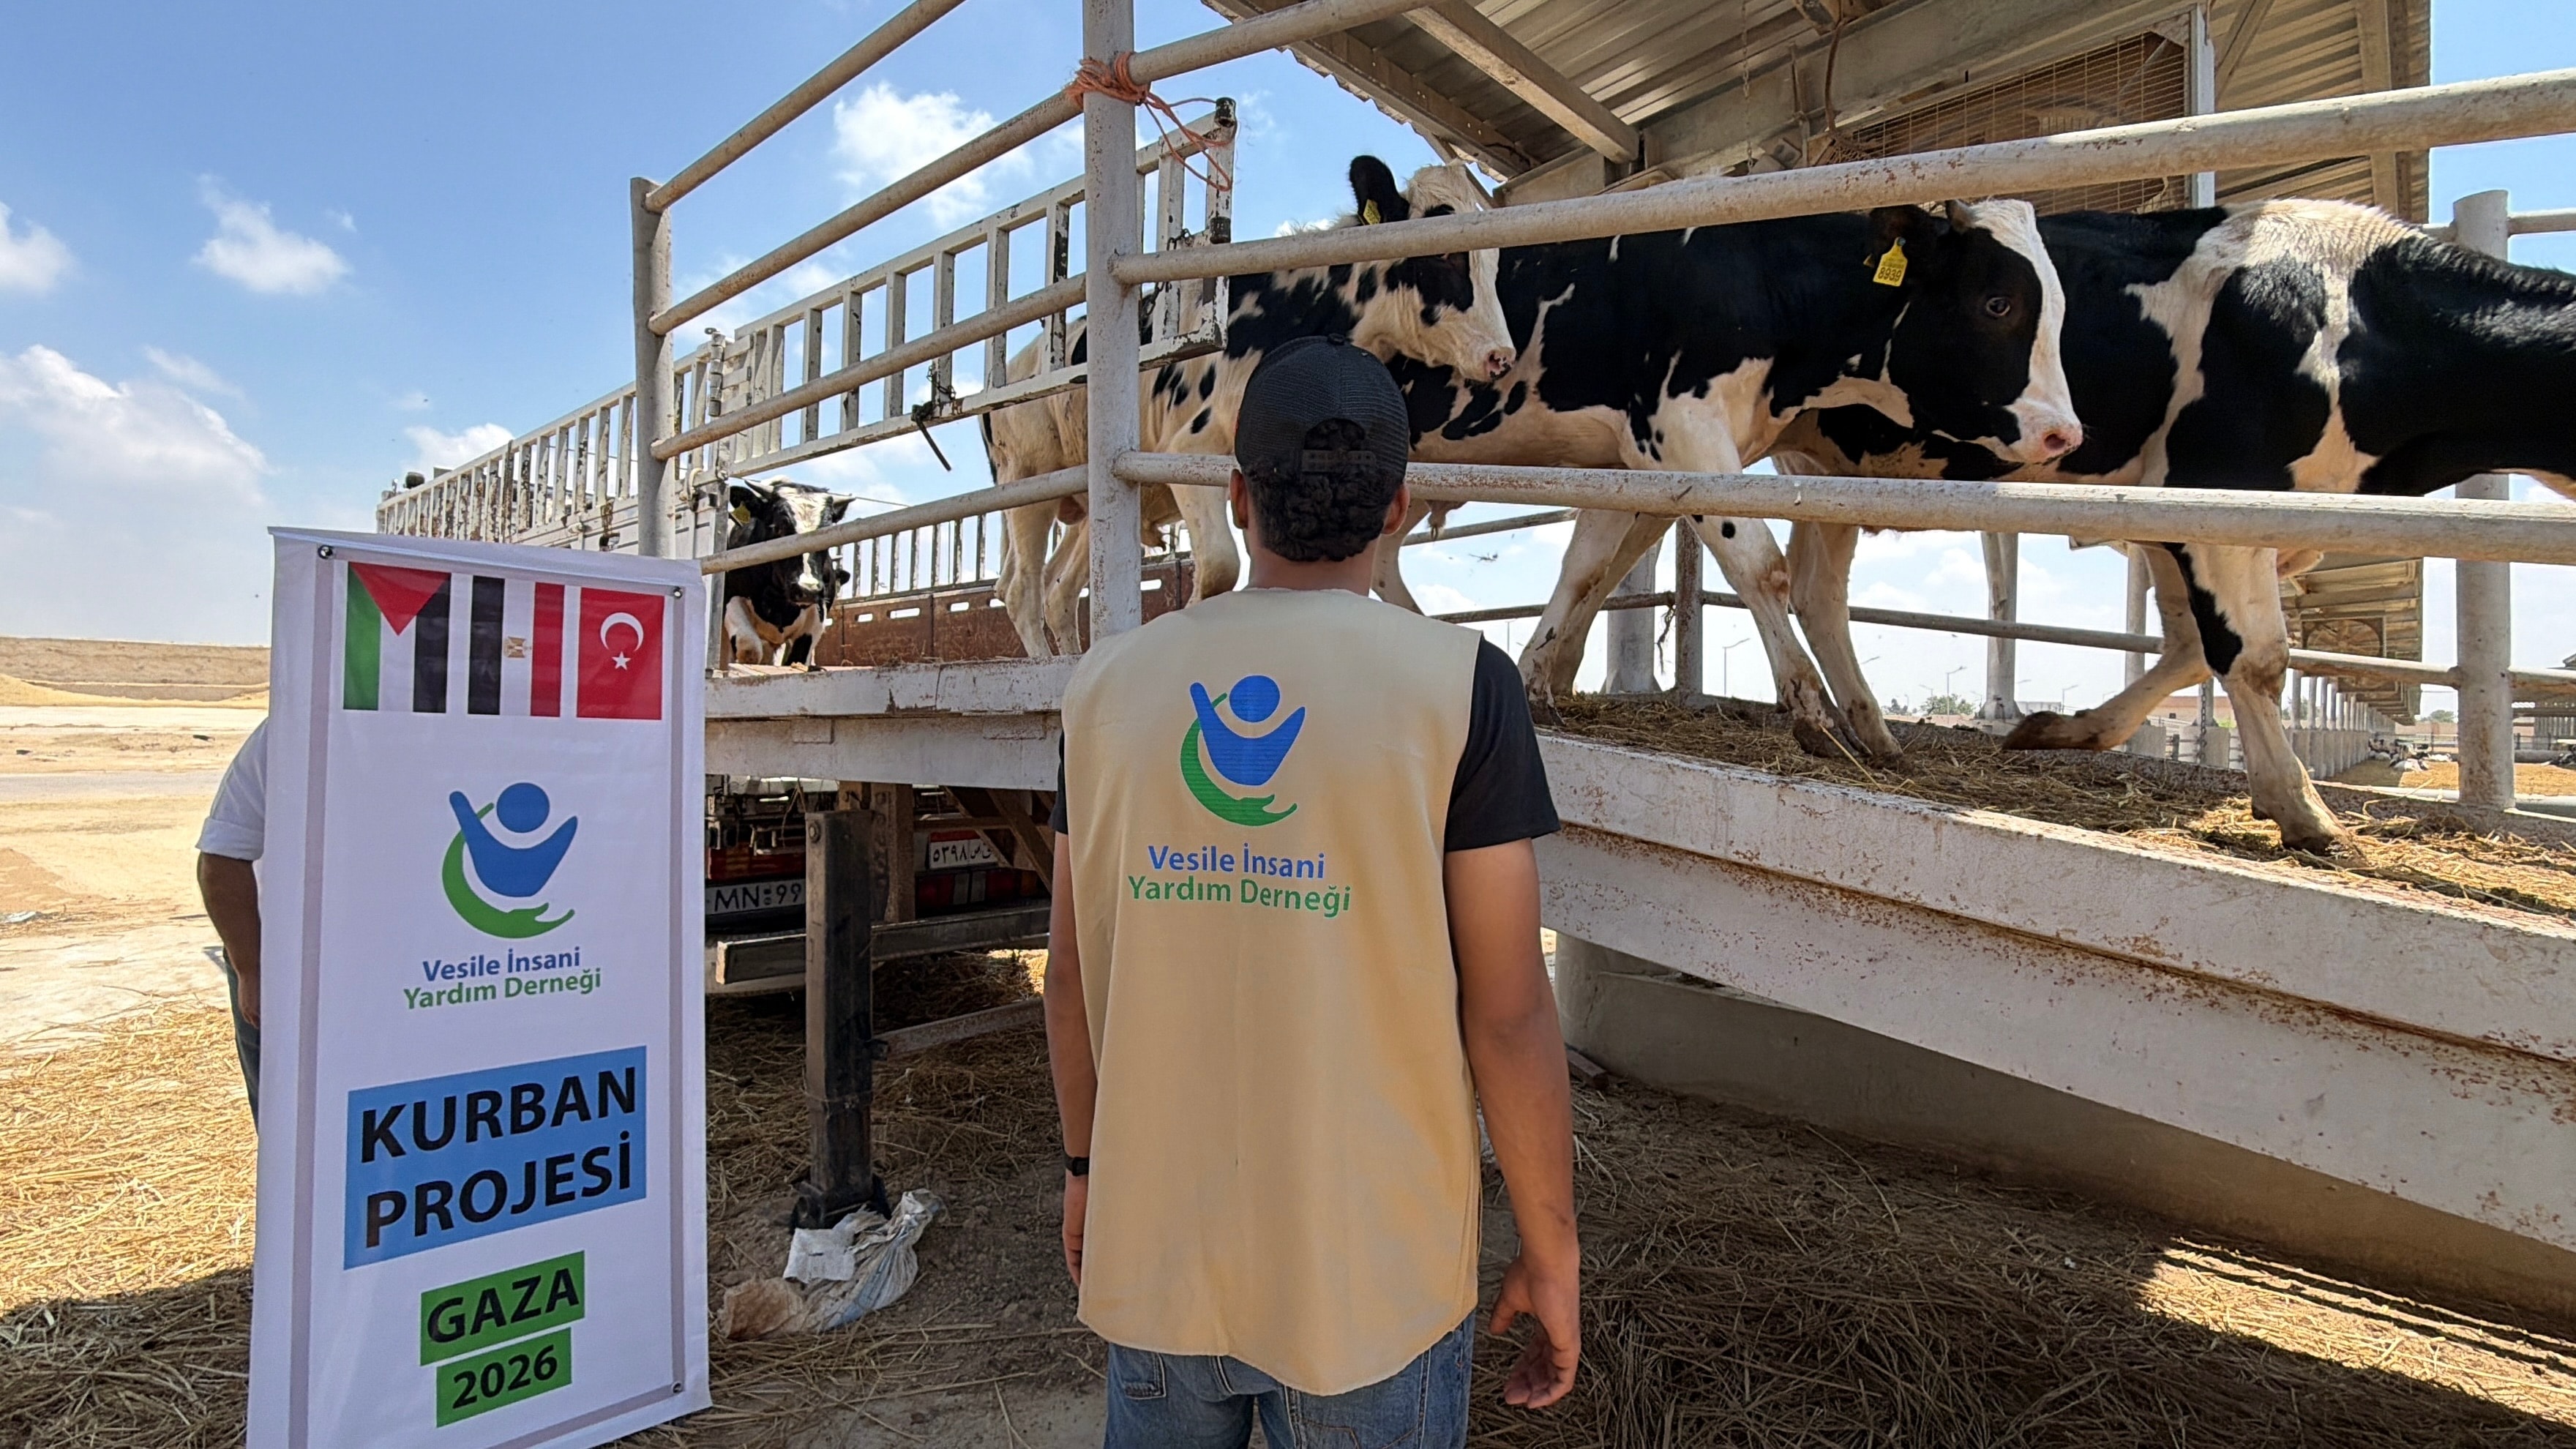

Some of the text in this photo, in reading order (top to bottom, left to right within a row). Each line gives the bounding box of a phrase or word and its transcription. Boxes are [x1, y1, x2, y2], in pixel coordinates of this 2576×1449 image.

[1878, 266, 1902, 282] 8939
[1147, 842, 1325, 879] Vesile İnsani
[1128, 875, 1352, 919] Yardım Derneği
[422, 946, 580, 982] Vesile İnsani
[403, 968, 602, 1010] Yardım Derneği
[361, 1066, 636, 1164] KURBAN
[365, 1131, 631, 1248] PROJESİ
[427, 1268, 580, 1344] GAZA
[452, 1344, 558, 1409] 2026
